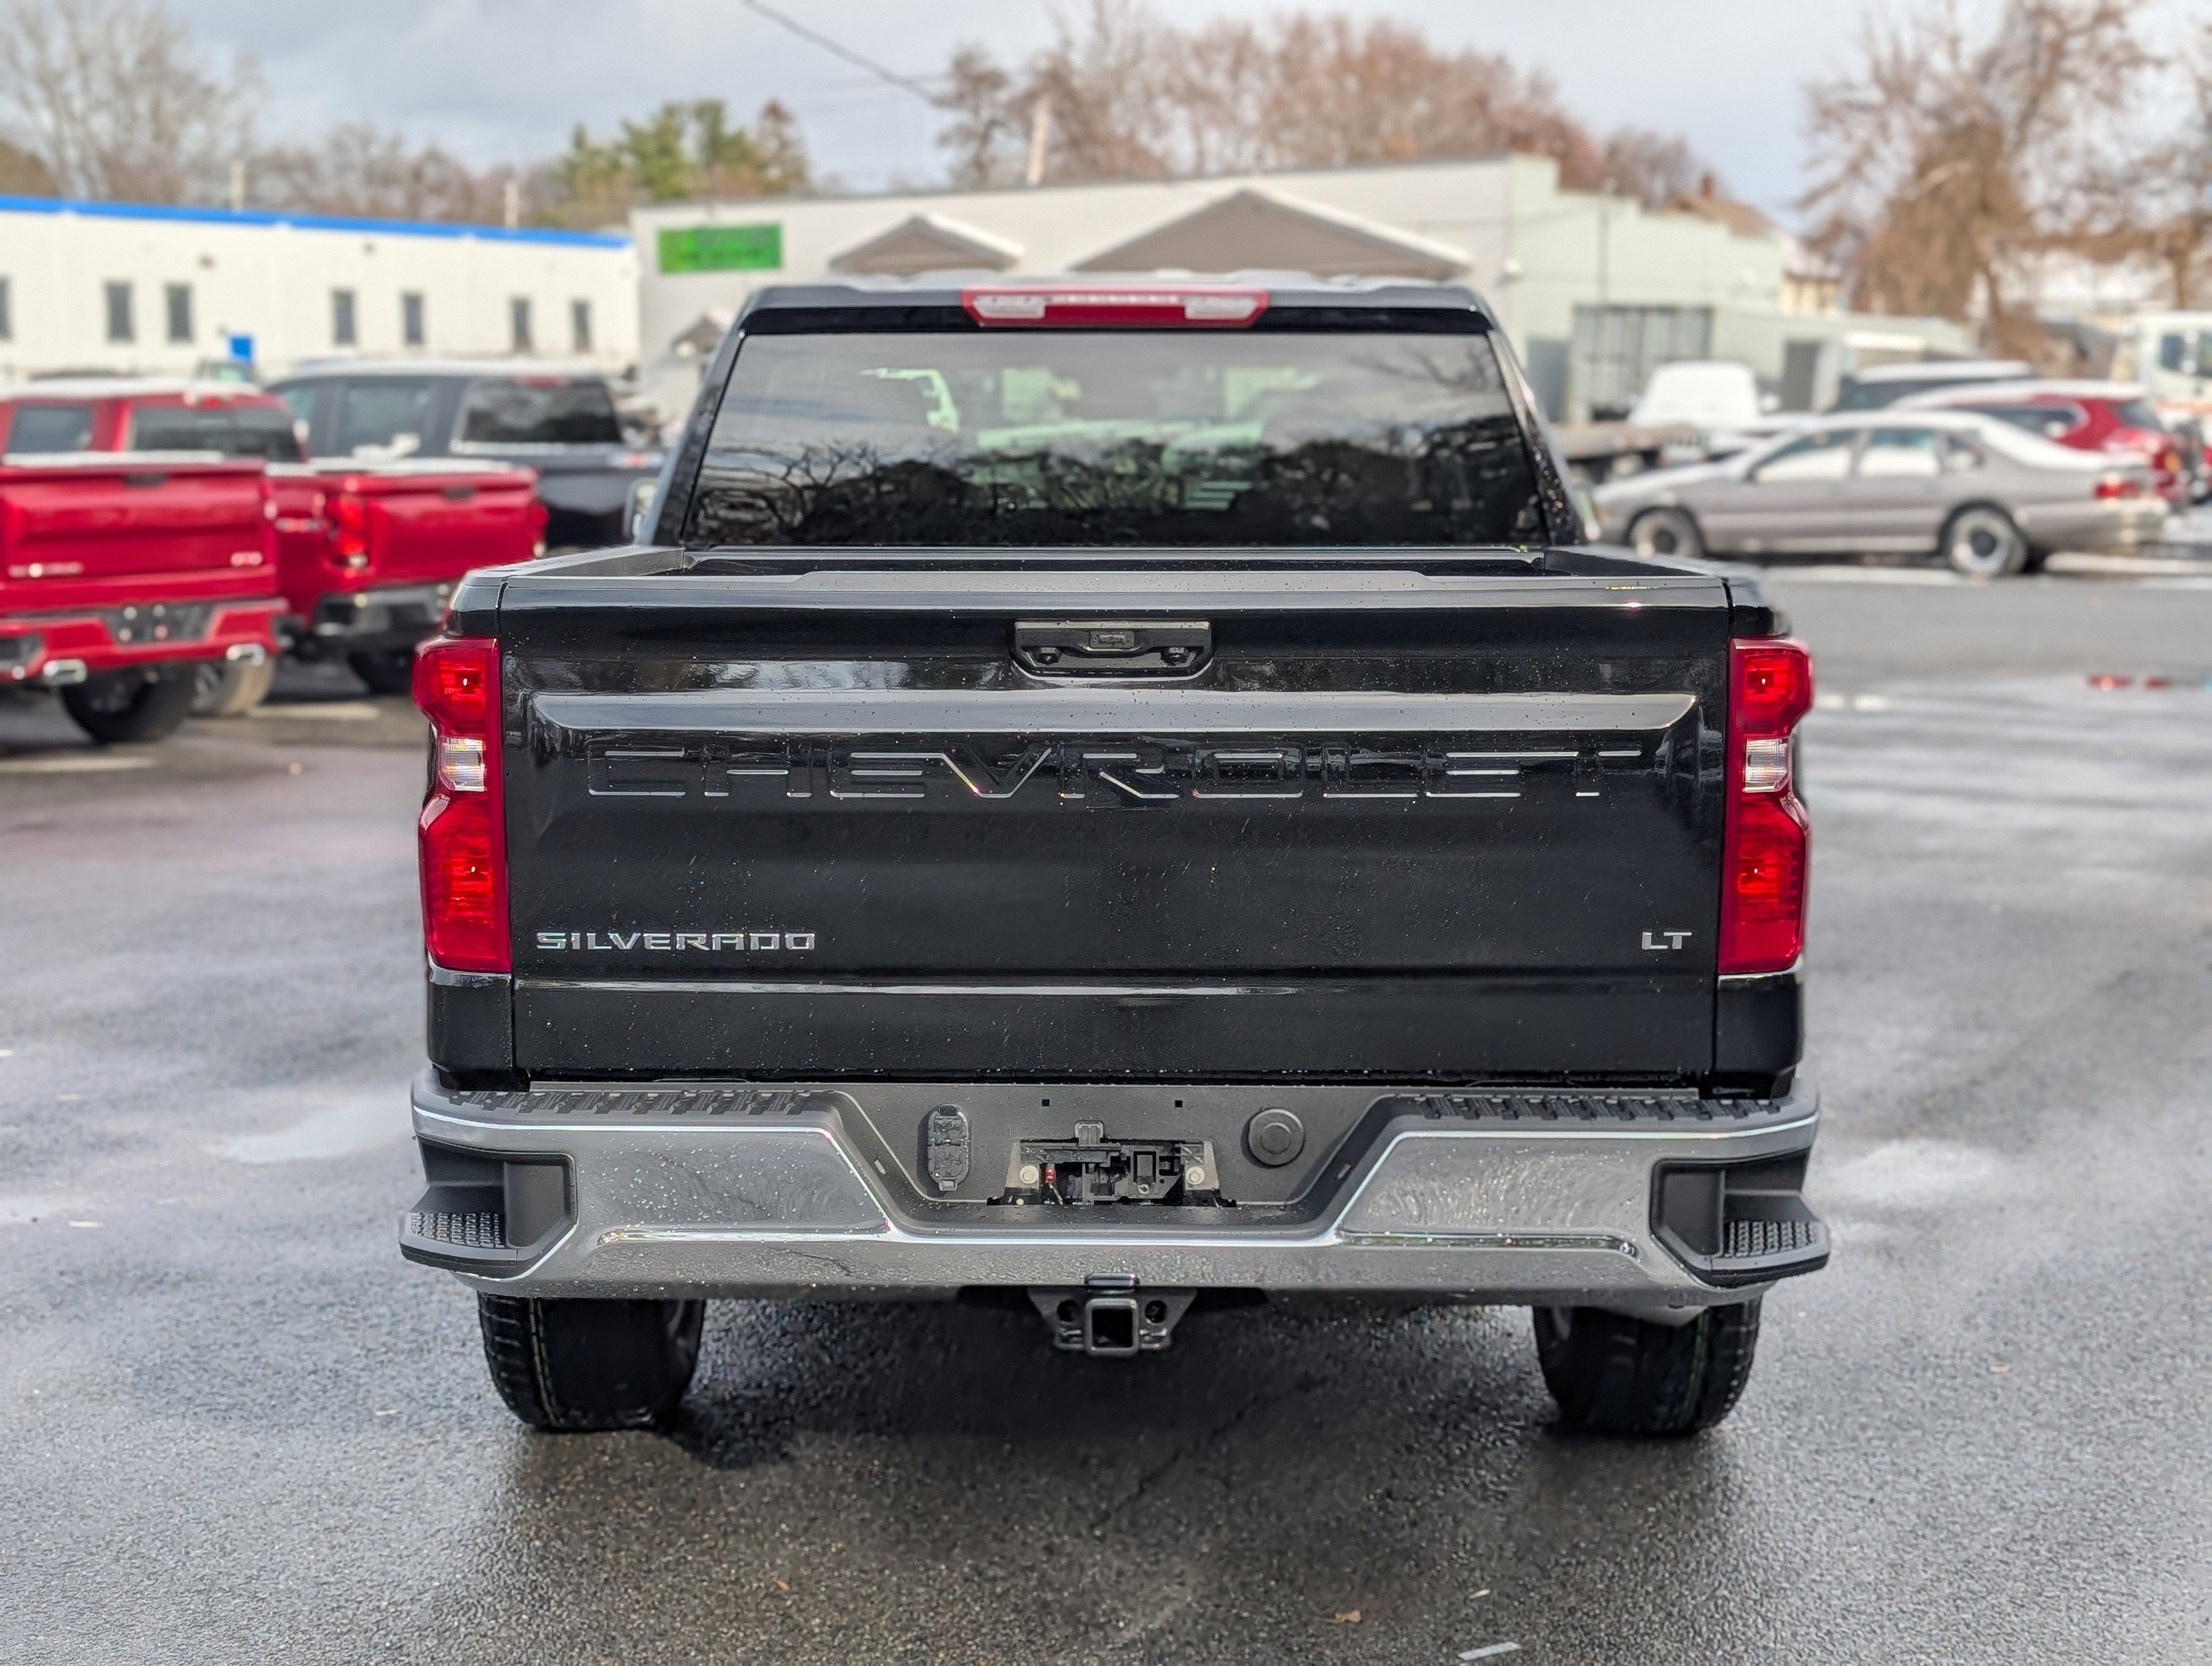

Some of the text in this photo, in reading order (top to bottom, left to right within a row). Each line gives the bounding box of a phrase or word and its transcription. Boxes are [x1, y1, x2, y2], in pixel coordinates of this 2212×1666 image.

[588, 743, 1642, 798] CHEVROLET
[536, 932, 815, 951] SILVERADO
[1642, 932, 1693, 950] LT
